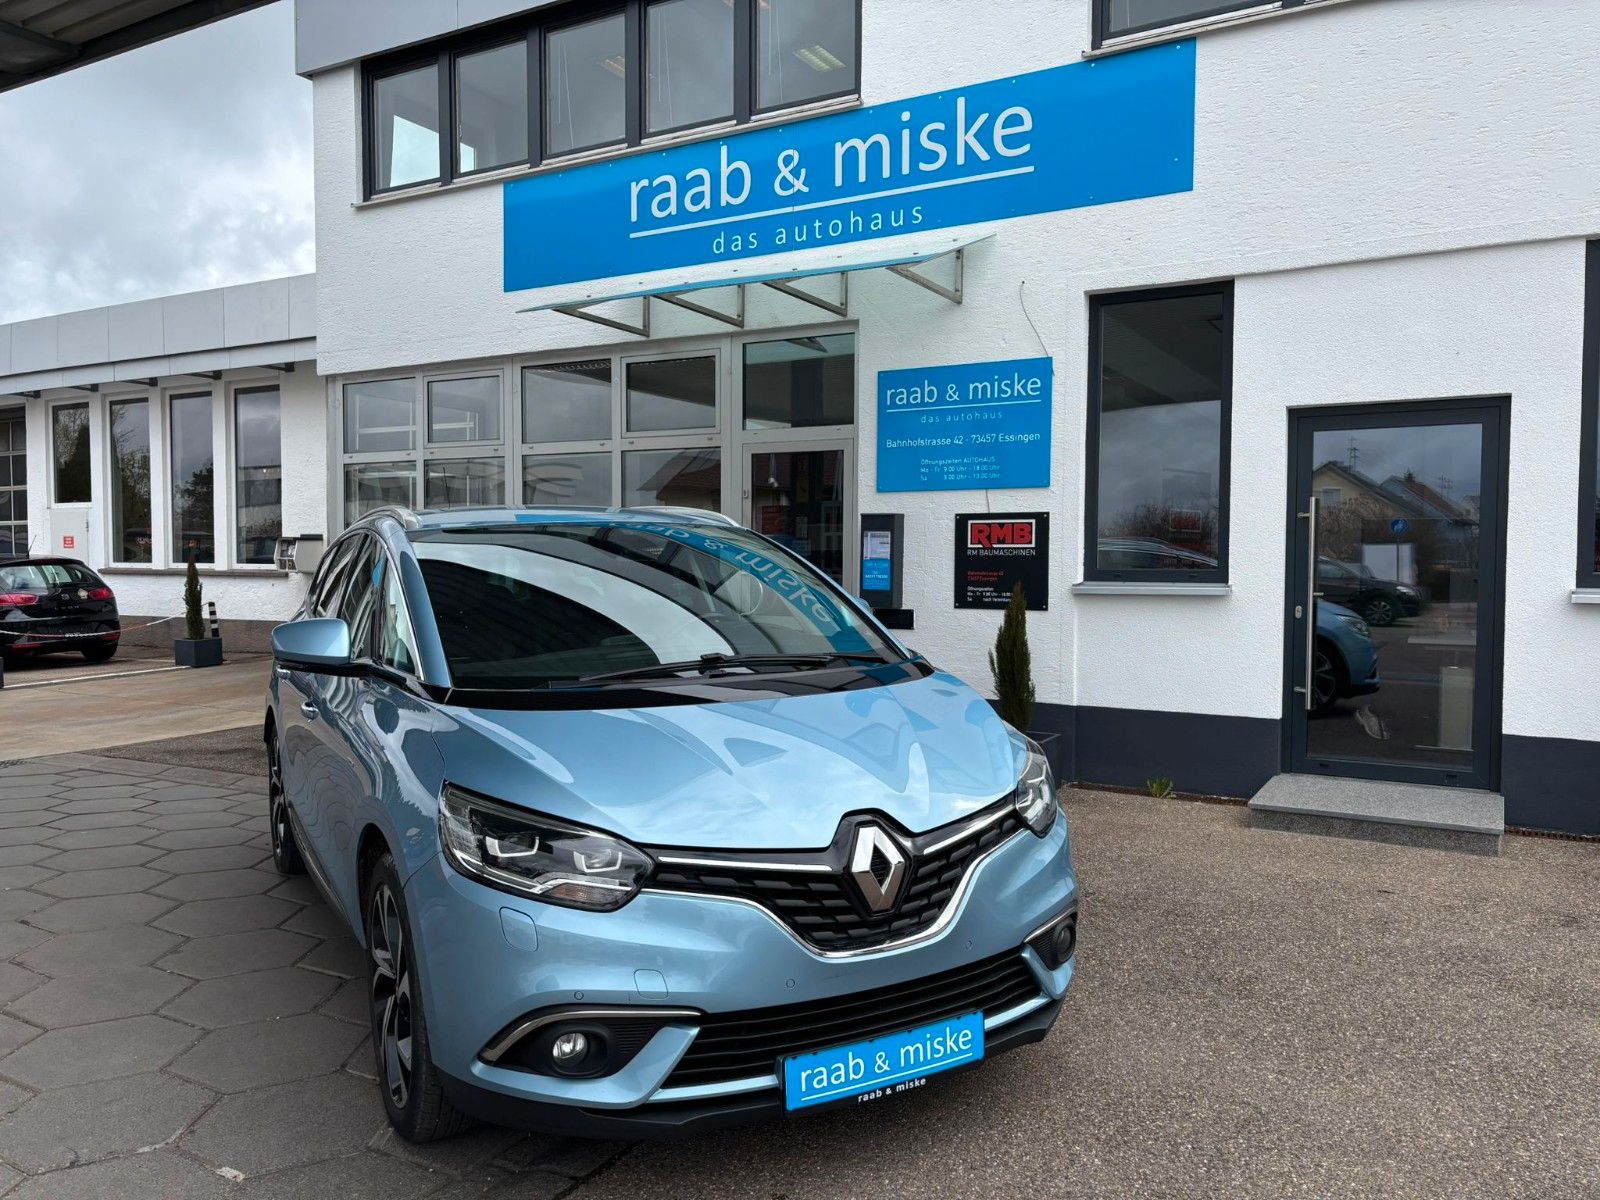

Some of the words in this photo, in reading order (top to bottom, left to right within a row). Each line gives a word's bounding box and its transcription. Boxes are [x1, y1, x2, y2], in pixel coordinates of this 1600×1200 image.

[629, 145, 752, 223] raab
[774, 149, 809, 197] &
[834, 96, 1034, 187] miske
[712, 232, 759, 255] das
[775, 204, 924, 244] autohaus
[886, 380, 938, 405] raab
[946, 384, 960, 401] &
[969, 373, 1041, 400] miske
[921, 414, 940, 423] das
[946, 411, 1003, 422] autohaus
[886, 437, 951, 448] Bahnhofstrasse
[953, 435, 964, 445] 42
[971, 433, 996, 444] 73457
[999, 432, 1041, 444] Essingen
[970, 522, 1033, 548] RMB
[979, 548, 1036, 556] BAUMASCHINEN
[801, 1051, 865, 1092] raab
[874, 1051, 890, 1074] &
[900, 1026, 973, 1067] miske
[858, 1090, 882, 1103] raab
[885, 1087, 892, 1095] &
[896, 1077, 926, 1093] miske
